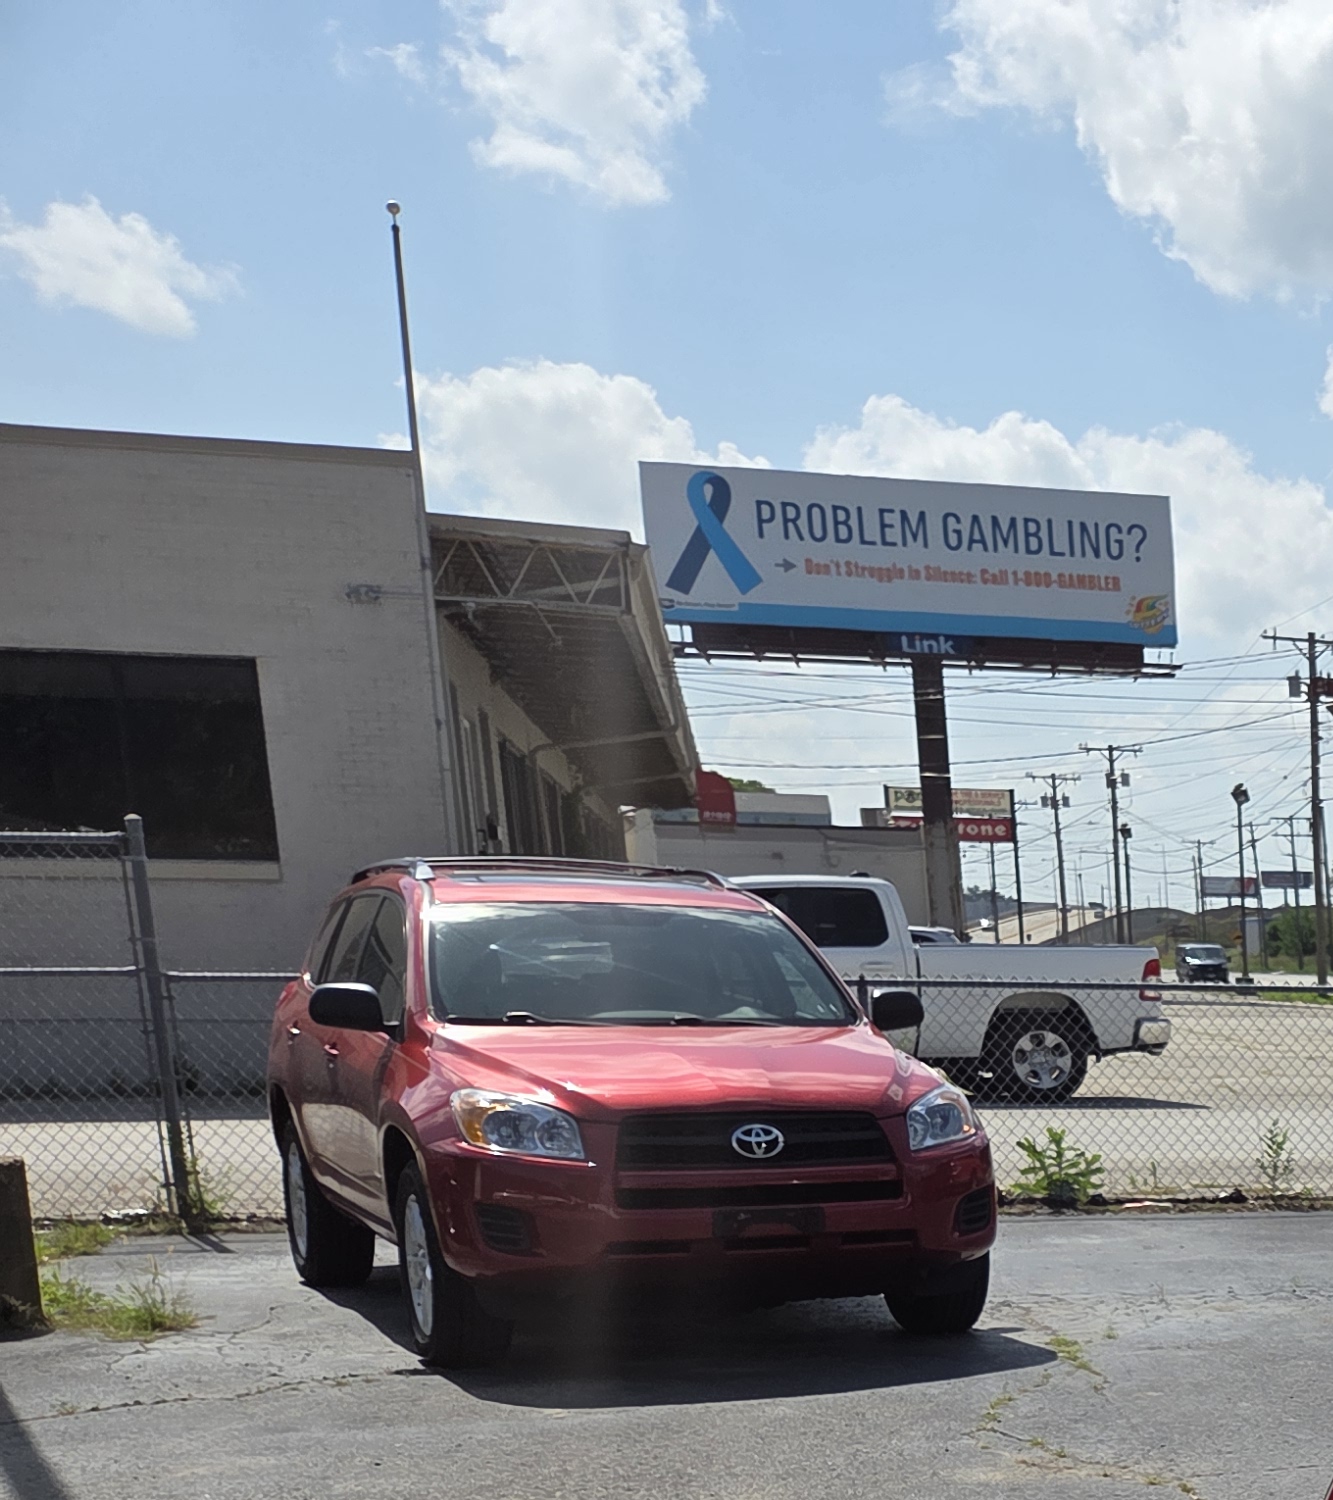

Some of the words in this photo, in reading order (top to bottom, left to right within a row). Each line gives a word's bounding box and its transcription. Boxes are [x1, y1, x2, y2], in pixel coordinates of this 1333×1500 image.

[755, 498, 929, 550] PROBLEM
[941, 510, 1148, 563] GAMBLING?
[804, 557, 843, 577] Don't
[845, 559, 905, 584] Struggle
[980, 567, 1009, 586] Call
[1011, 570, 1123, 592] 1-800-GAMBLER
[901, 634, 956, 655] Link
